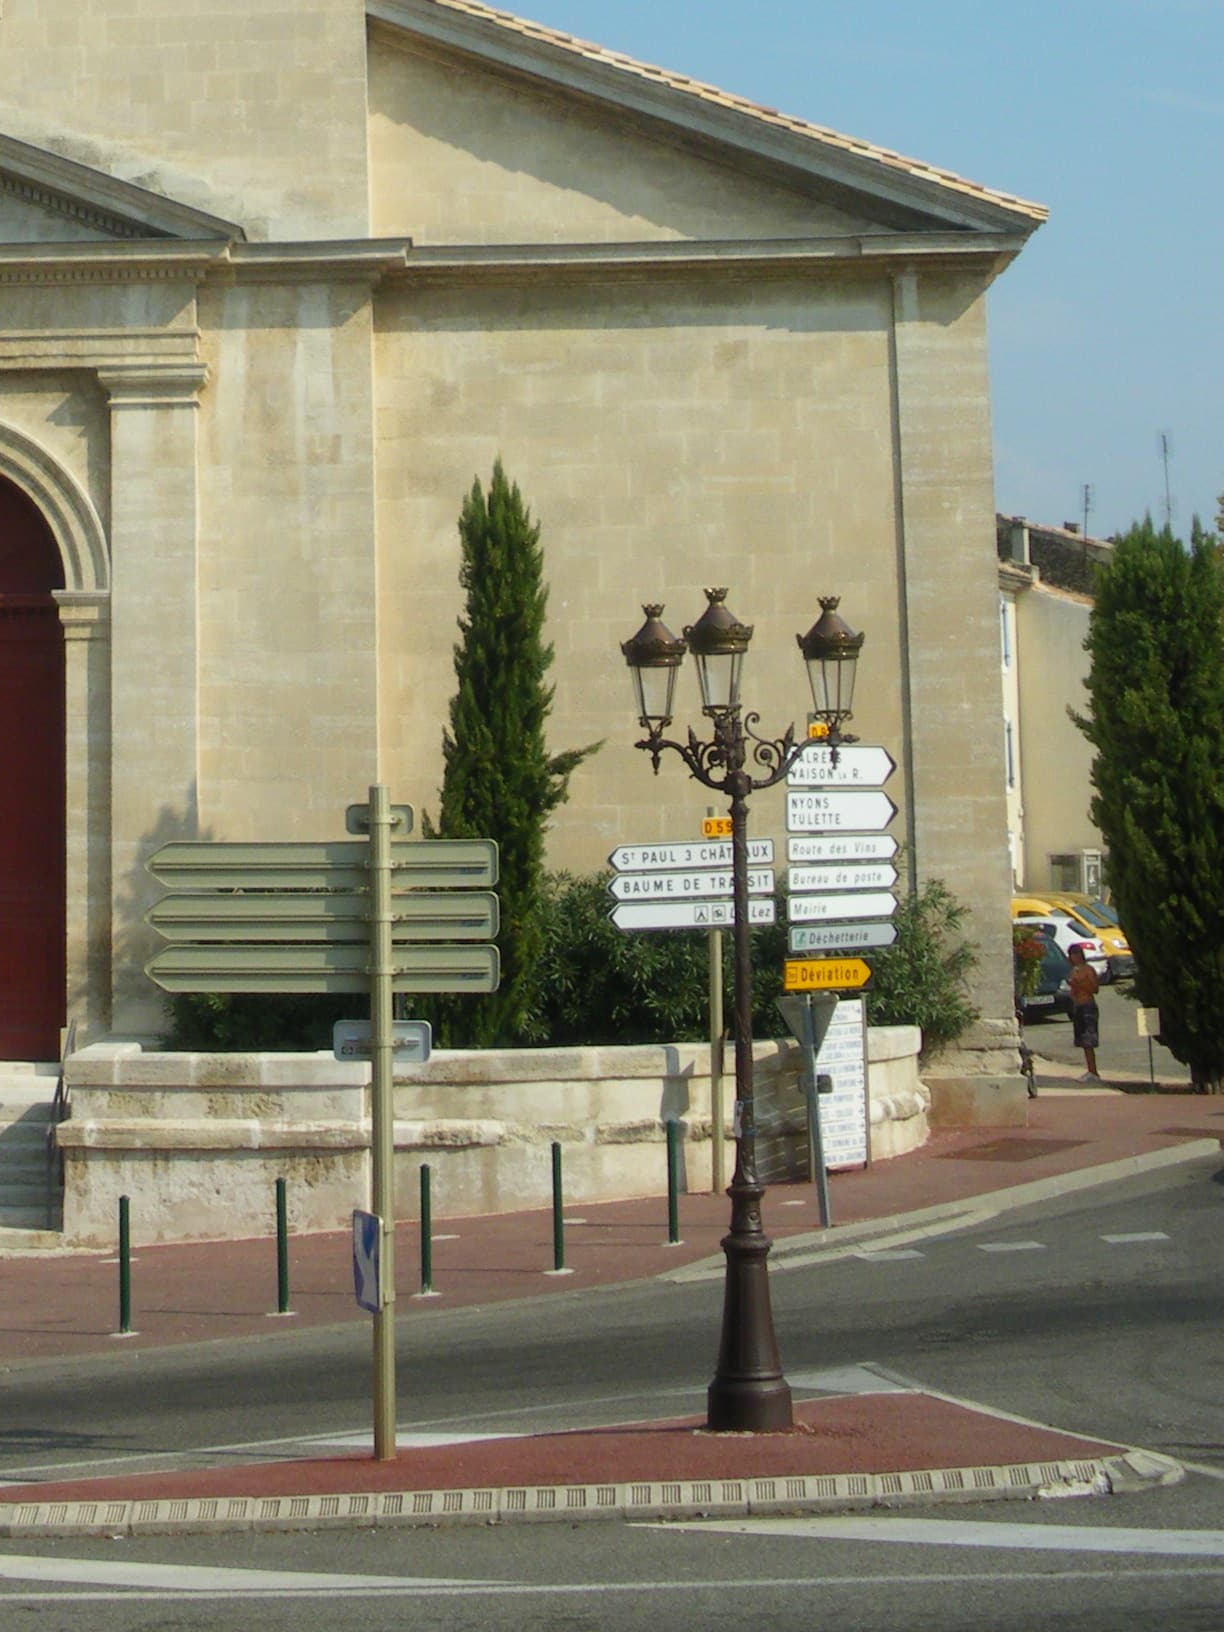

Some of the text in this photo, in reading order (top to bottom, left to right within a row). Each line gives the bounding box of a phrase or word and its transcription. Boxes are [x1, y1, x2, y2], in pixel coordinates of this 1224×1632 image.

[791, 798, 830, 809] NYONS
[792, 813, 841, 825] TULETTE
[704, 822, 713, 834] D
[642, 849, 676, 863] PAUL
[685, 849, 692, 861] 3
[700, 845, 769, 860] CHÂTUX
[791, 841, 877, 855] Route des Vins
[623, 874, 769, 894] BAUME DE TRASIT
[792, 871, 882, 885] Bureau de poste
[751, 906, 771, 918] Lez
[793, 903, 827, 915] Mairie
[801, 967, 859, 982] Déviation
